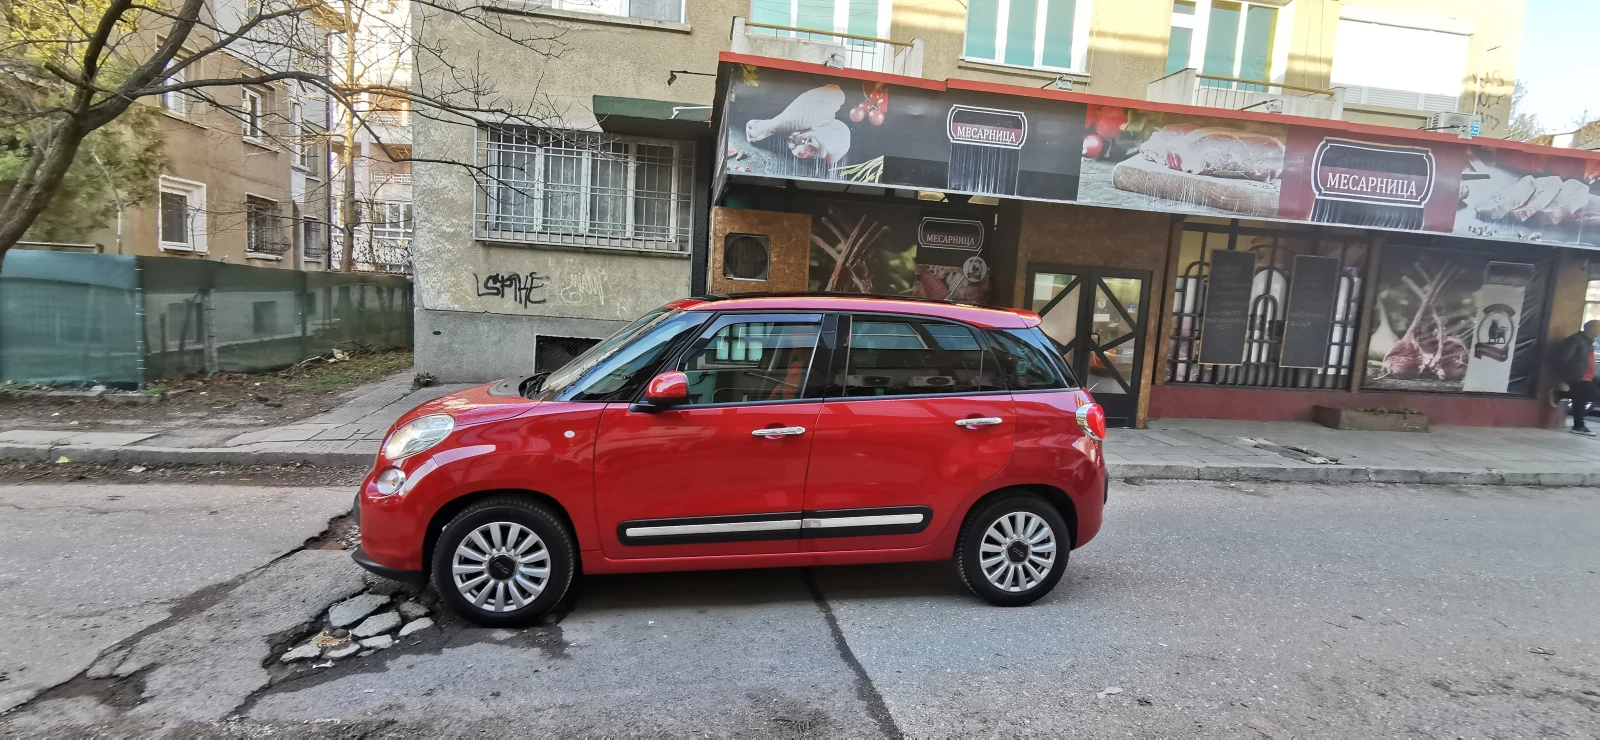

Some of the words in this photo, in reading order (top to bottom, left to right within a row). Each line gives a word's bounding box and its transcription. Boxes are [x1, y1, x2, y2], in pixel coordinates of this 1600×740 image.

[957, 126, 1016, 143] МЕСАРНИЦА
[1326, 172, 1417, 198] МЕСАРНИЦА
[926, 234, 975, 246] МЕСАРНИЦА
